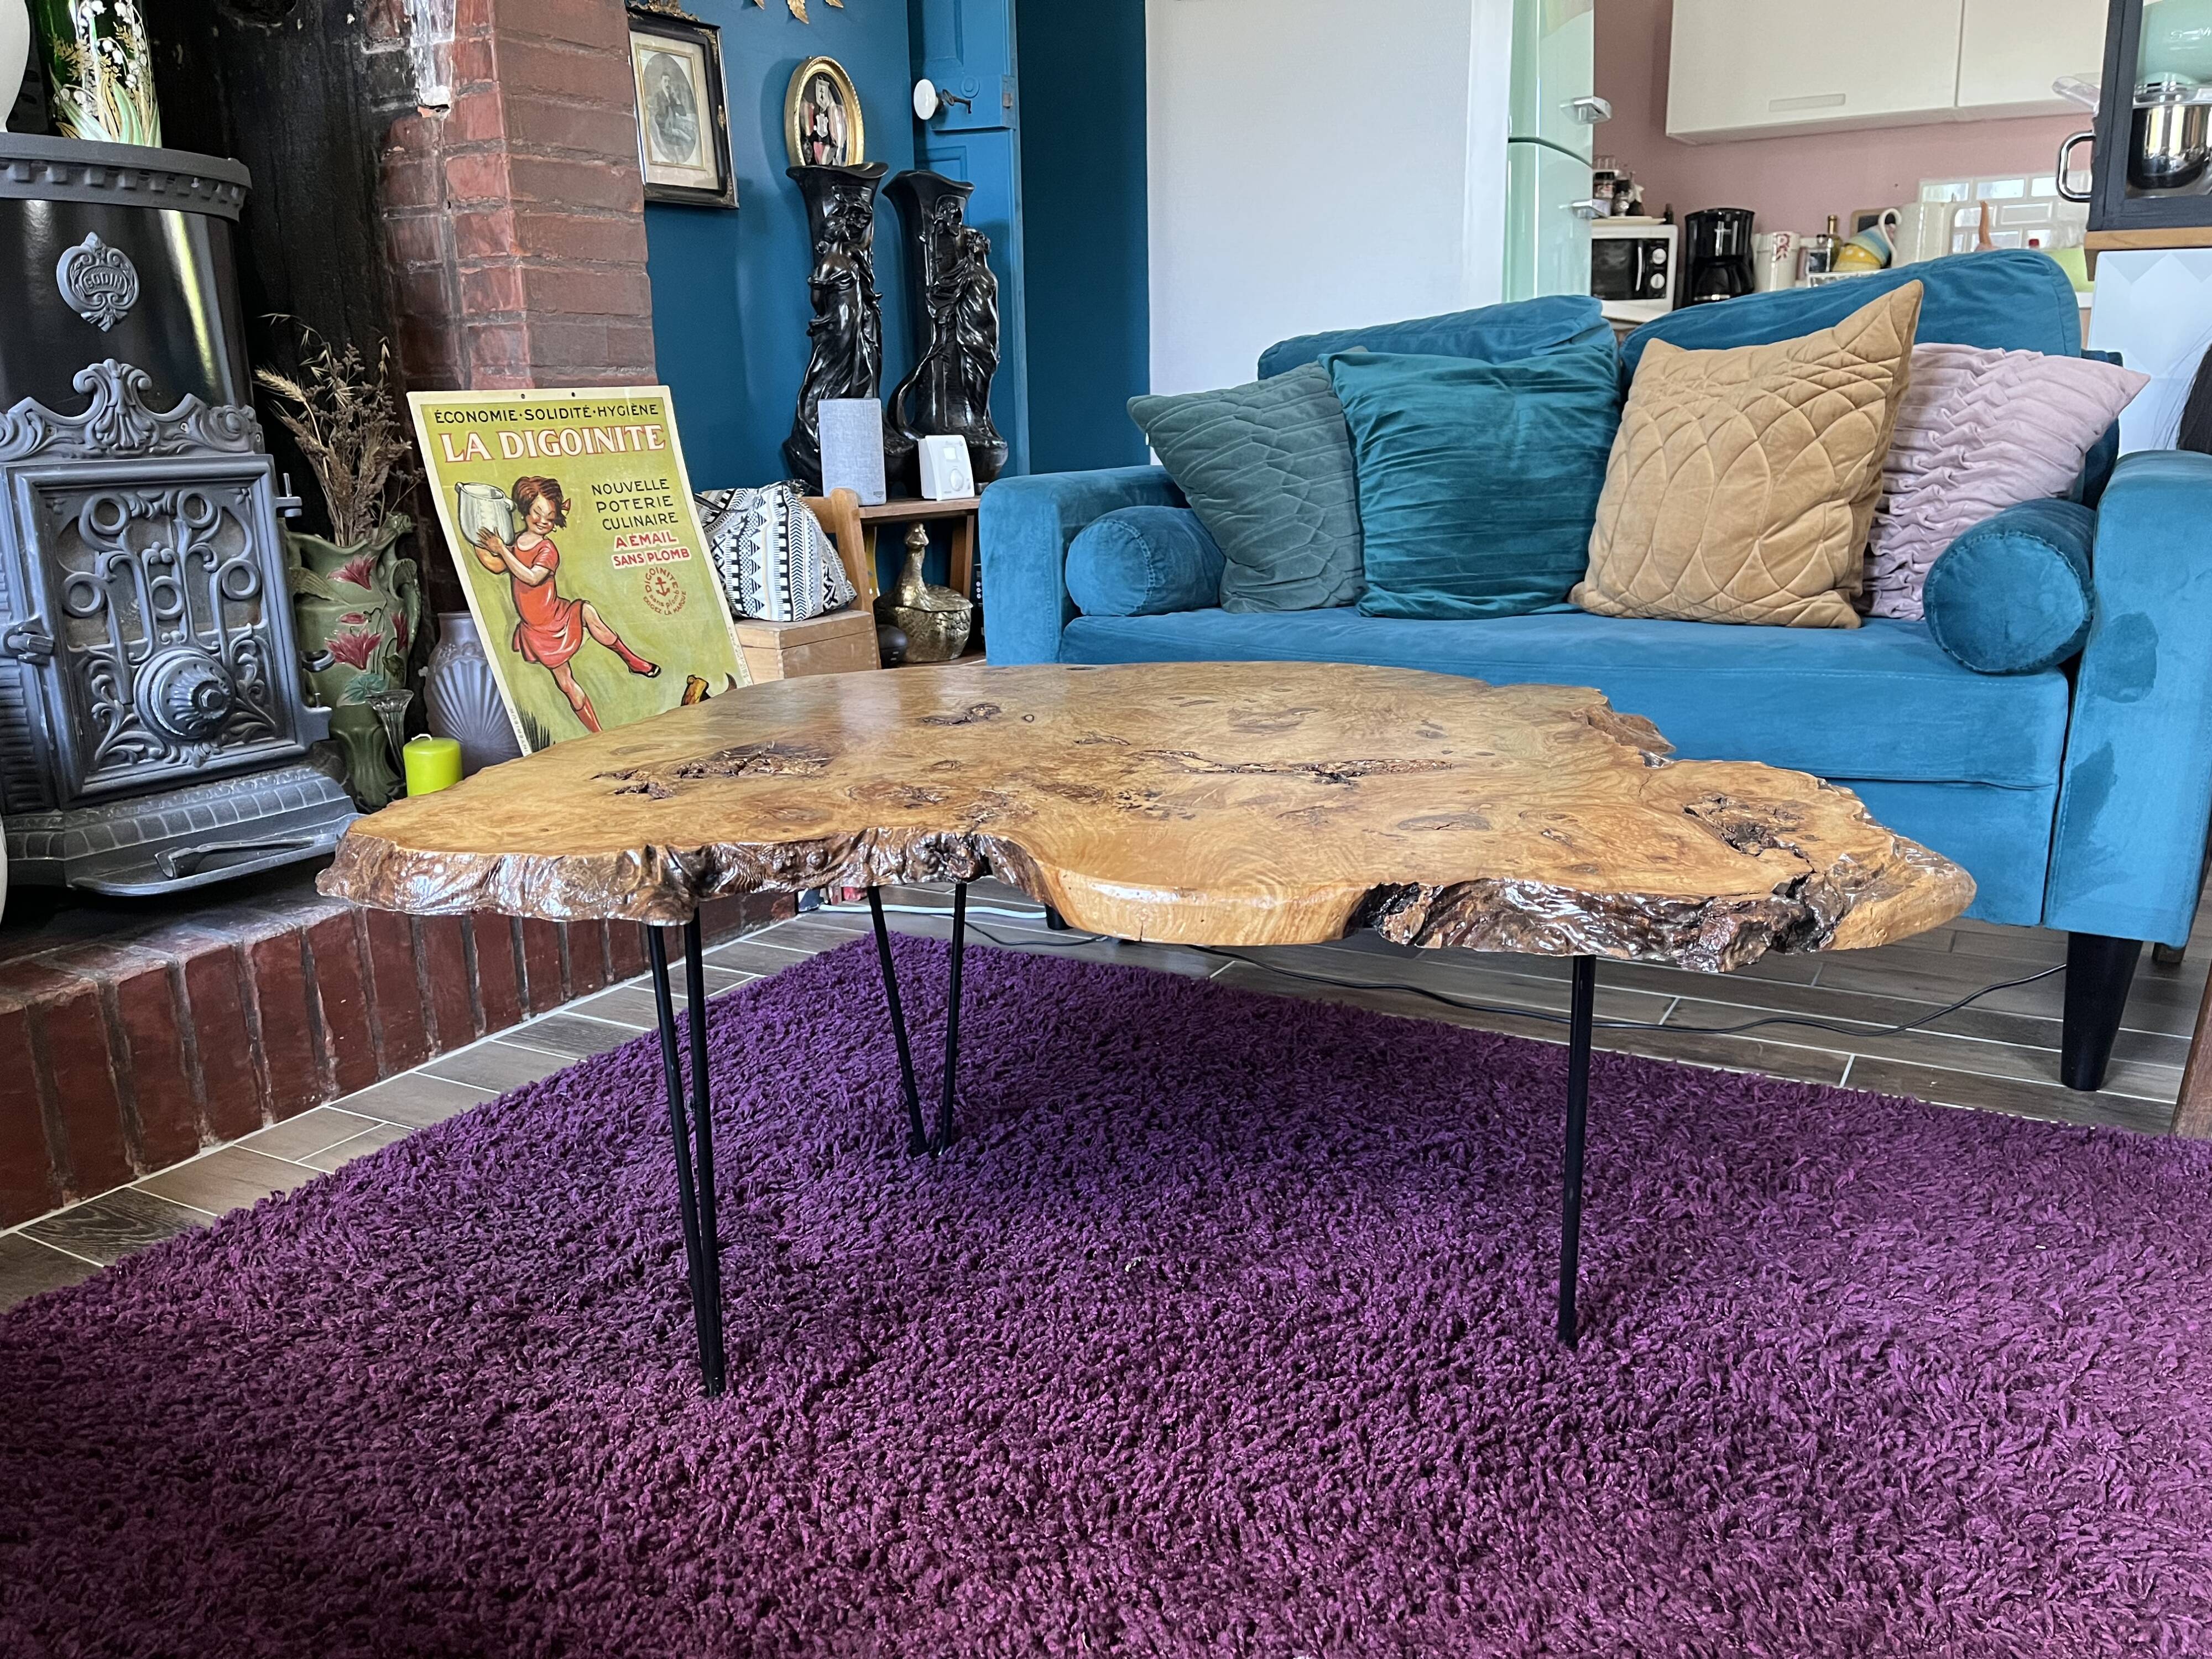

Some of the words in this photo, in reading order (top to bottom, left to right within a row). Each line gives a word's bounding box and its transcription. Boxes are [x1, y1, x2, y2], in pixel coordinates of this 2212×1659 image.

[83, 272, 123, 289] GODIN
[434, 409, 518, 424] ÉCONOMIE
[525, 405, 592, 421] SOLIDITÉ
[598, 404, 659, 418] HYGIÈNE
[439, 432, 495, 463] LA
[497, 424, 666, 460] DIGOINITE
[591, 478, 670, 496] NOUVELLE
[596, 495, 674, 513] POTERIE
[602, 512, 679, 530] CULINAIRE
[615, 536, 628, 549] A
[629, 531, 677, 546] ÉMAIL
[613, 554, 645, 566] SANS
[647, 548, 690, 562] PLOMB
[644, 566, 679, 593] DIGOINITE
[649, 594, 664, 607] sans
[666, 589, 680, 609] plomb
